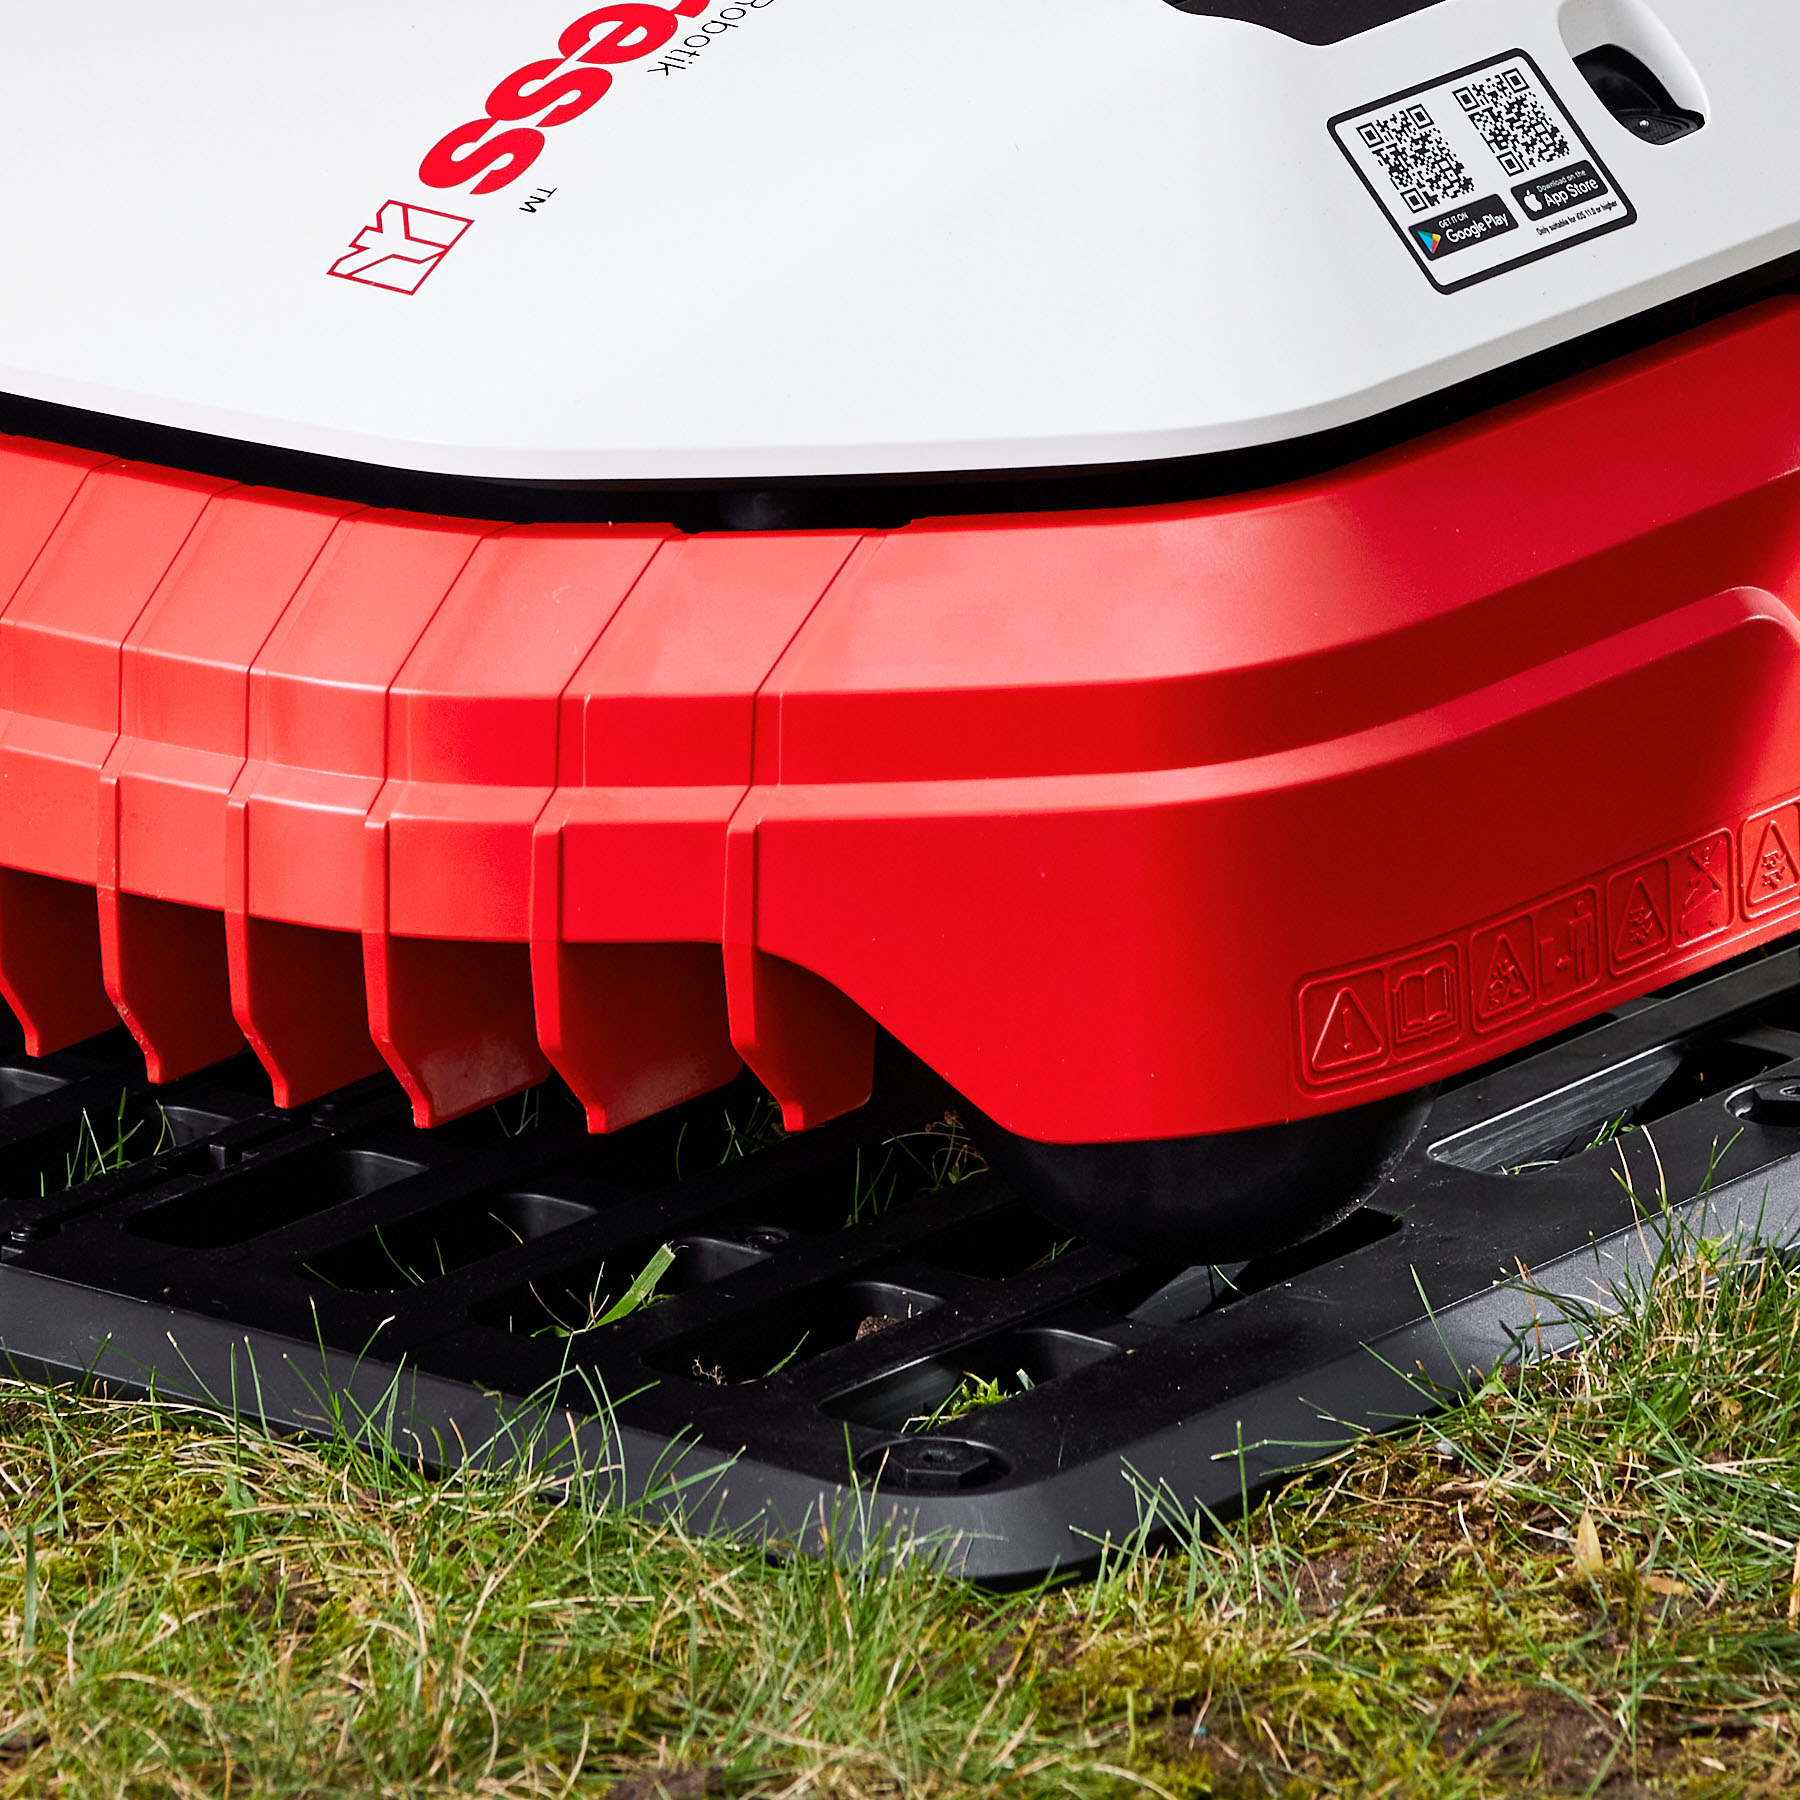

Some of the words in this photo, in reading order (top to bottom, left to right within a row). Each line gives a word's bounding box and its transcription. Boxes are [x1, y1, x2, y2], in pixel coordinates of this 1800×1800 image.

[1536, 176, 1568, 192] Download
[1575, 170, 1586, 178] the
[1544, 190, 1568, 206] App
[1566, 179, 1598, 197] Store
[1438, 218, 1452, 228] GET
[1450, 216, 1458, 224] IT
[1457, 212, 1468, 222] ON
[1446, 220, 1487, 242] Google
[1482, 213, 1508, 228] Play
